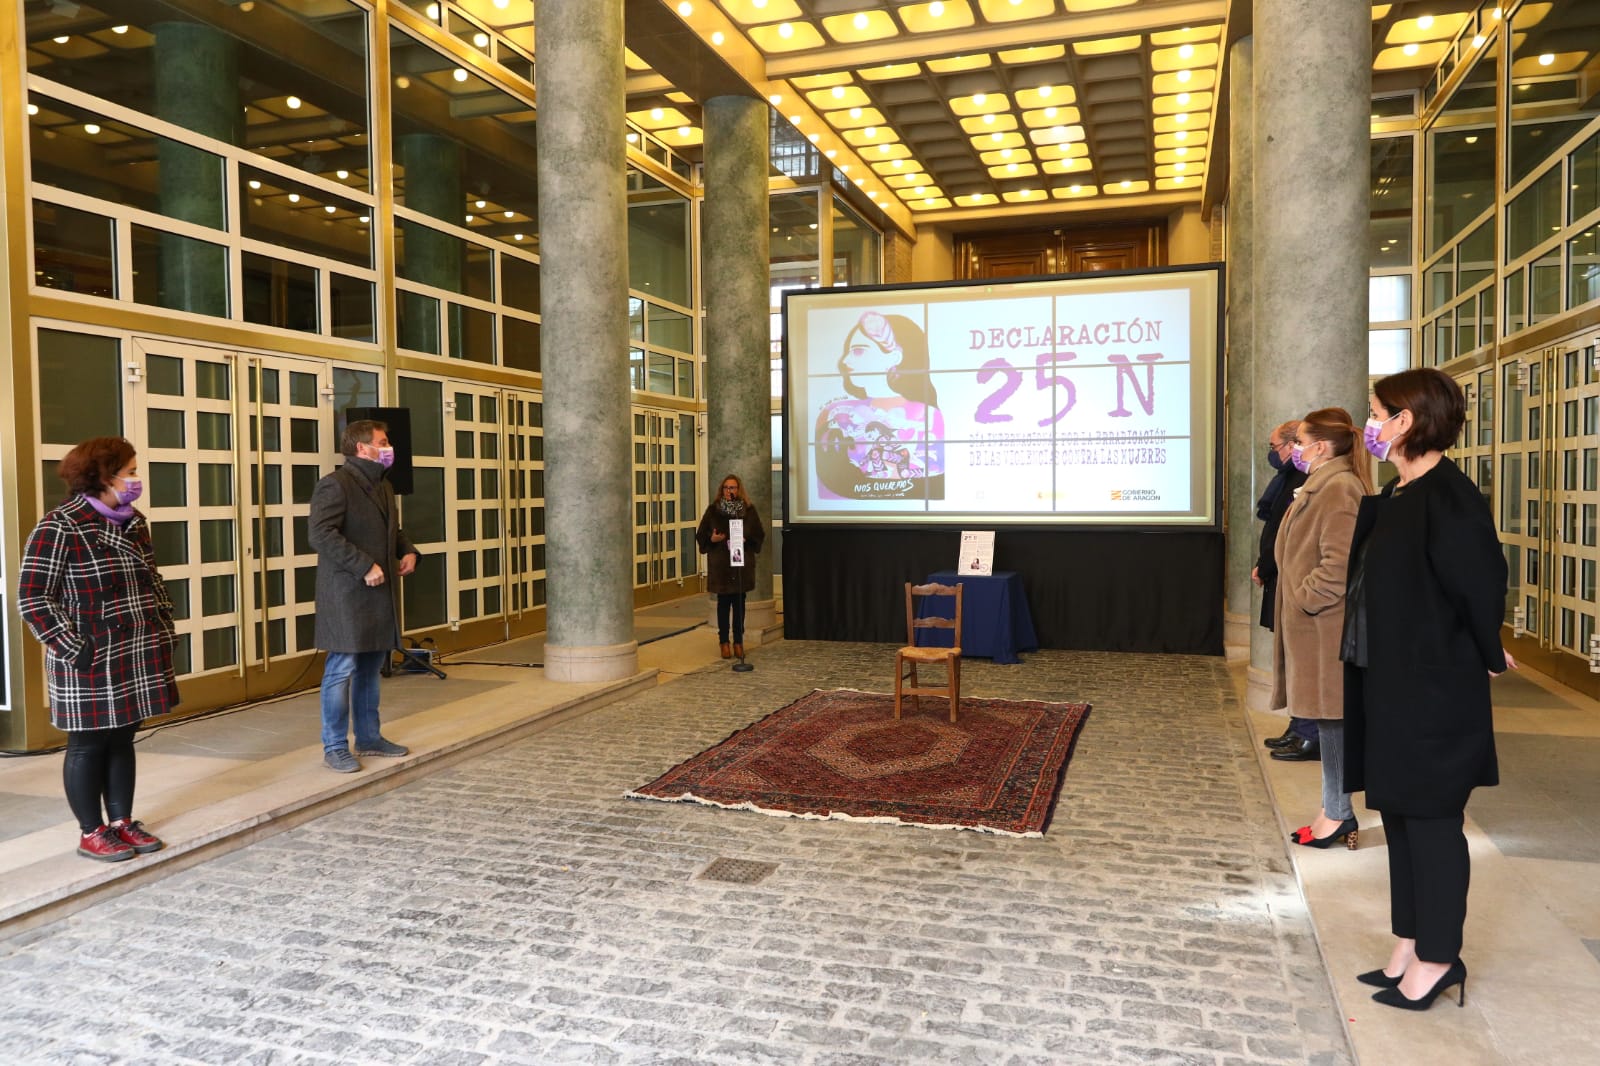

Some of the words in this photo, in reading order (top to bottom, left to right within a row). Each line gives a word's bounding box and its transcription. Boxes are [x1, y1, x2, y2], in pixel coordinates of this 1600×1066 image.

[969, 317, 1163, 350] DECLARACIÓN
[974, 352, 1077, 428] 25
[1107, 352, 1164, 418] N
[1095, 427, 1166, 446] ERRADICACIÓN
[969, 450, 981, 467] DE
[984, 450, 1001, 467] LAS
[1062, 448, 1098, 466] CONTRA
[1100, 448, 1119, 465] LAS
[1121, 447, 1167, 465] MUJERES
[854, 483, 871, 493] NOS
